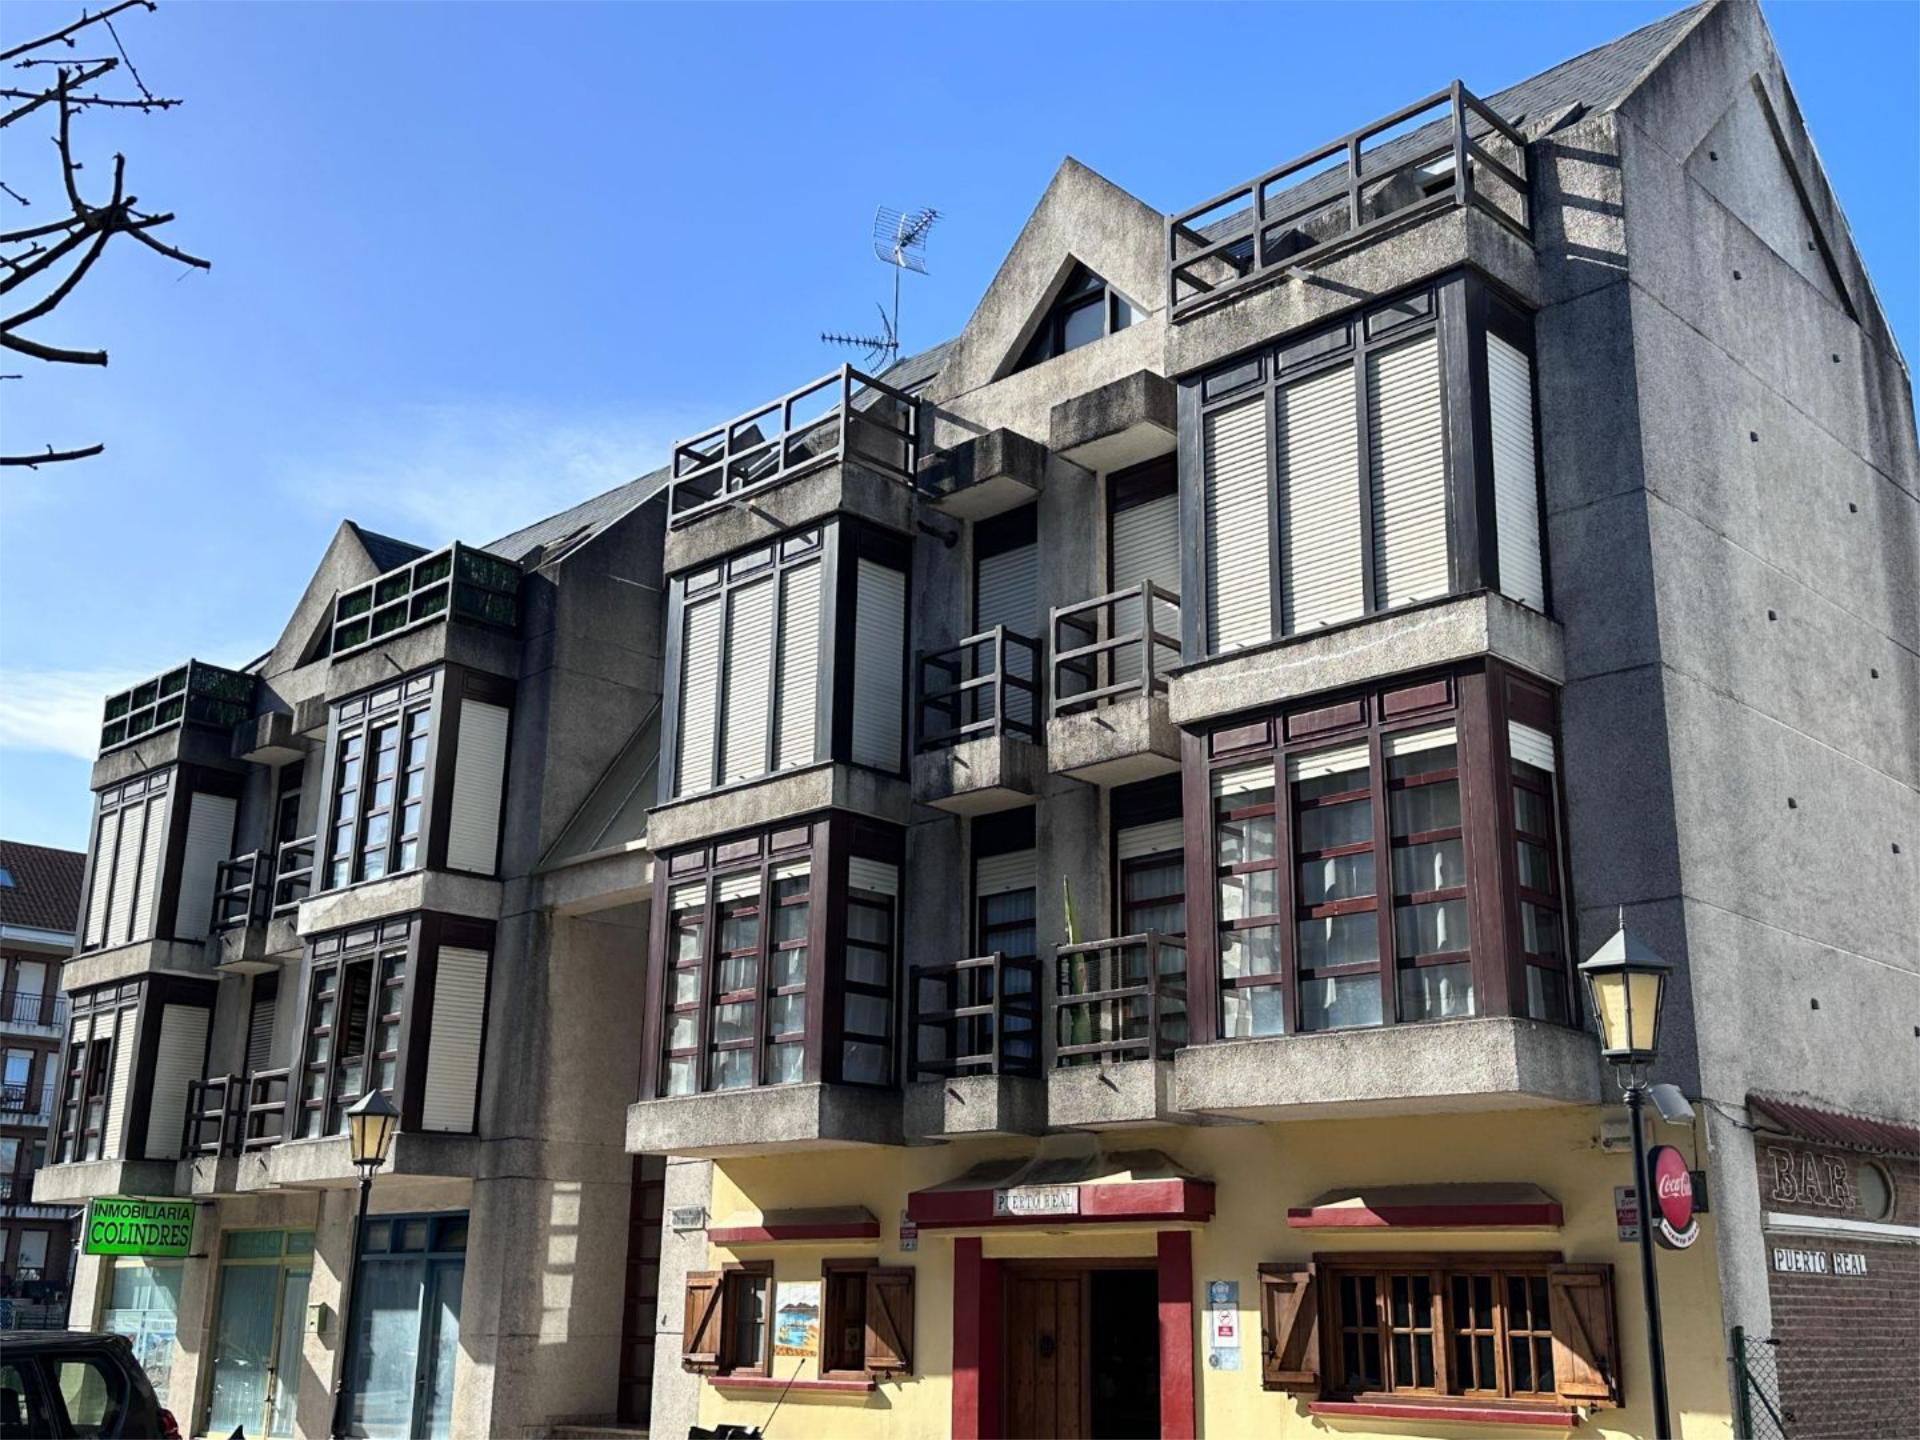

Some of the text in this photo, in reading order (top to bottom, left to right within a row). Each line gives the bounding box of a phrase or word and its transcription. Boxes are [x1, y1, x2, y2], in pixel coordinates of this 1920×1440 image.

[1767, 1146, 1856, 1209] BAR
[94, 1203, 191, 1221] INMOBILIARIA
[91, 1222, 190, 1247] COLINDRES
[1775, 1249, 1867, 1275] PUERTO REAL
